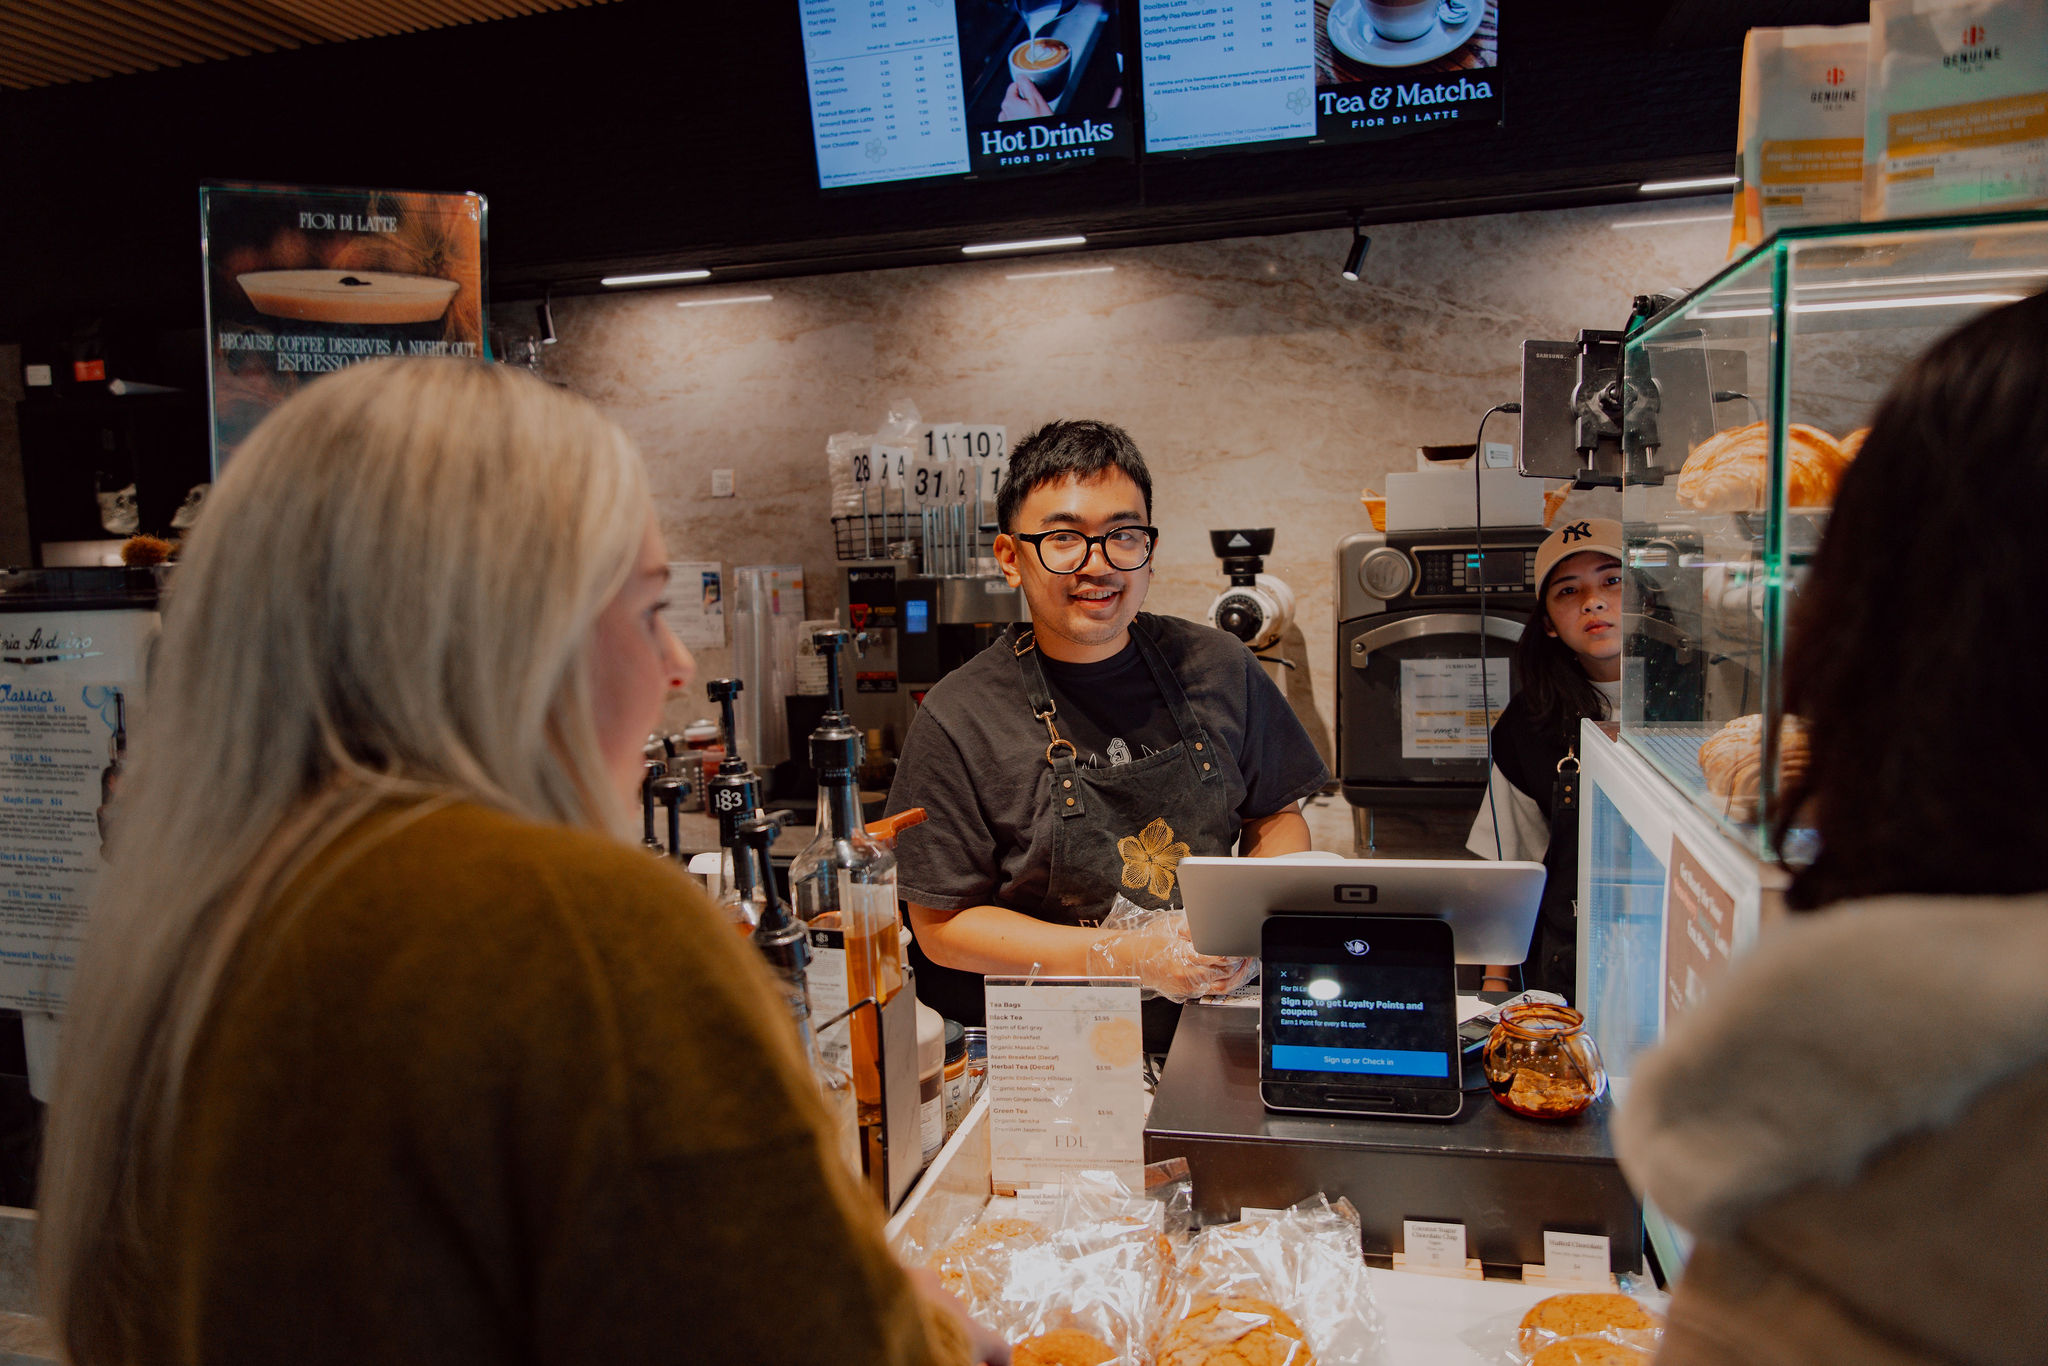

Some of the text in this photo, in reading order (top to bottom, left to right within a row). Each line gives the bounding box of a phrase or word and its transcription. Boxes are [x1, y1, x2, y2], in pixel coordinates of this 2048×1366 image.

[1144, 8, 1218, 23] Butterfly Pea Flower Latte
[1144, 21, 1216, 36] Golden Turmeric Latte
[1144, 34, 1216, 49] Chaga Mushroom Latte
[1157, 53, 1171, 61] Bag
[1943, 47, 2001, 69] GENUINE
[1319, 77, 1493, 115] Tea & Matcha
[1810, 89, 1857, 104] GENUINE
[1351, 109, 1459, 129] FIOR DI LATTE
[981, 118, 1114, 155] Hot Drinks
[1000, 147, 1095, 166] FIOR DI LATTE
[299, 212, 397, 233] FIOR DI LATTE
[220, 332, 274, 351] BECAUSE
[277, 334, 326, 354] COFFEE
[329, 337, 391, 355] DESERVES
[395, 340, 405, 356] A
[409, 340, 449, 357] NIGHT
[277, 353, 350, 373] ESPRESSO
[963, 431, 990, 458] 10
[854, 454, 871, 482] 28
[1281, 997, 1424, 1011] Sign up to get Loyalty Points and
[1281, 1008, 1318, 1017] coupons
[1314, 1019, 1323, 1027] for
[1323, 1021, 1340, 1029] every
[1348, 1021, 1367, 1029] spent.
[1323, 1055, 1341, 1064] Sign
[1342, 1057, 1351, 1065] up
[1362, 1056, 1385, 1066] Check
[1386, 1058, 1394, 1066] in
[1055, 1135, 1088, 1148] FDL
